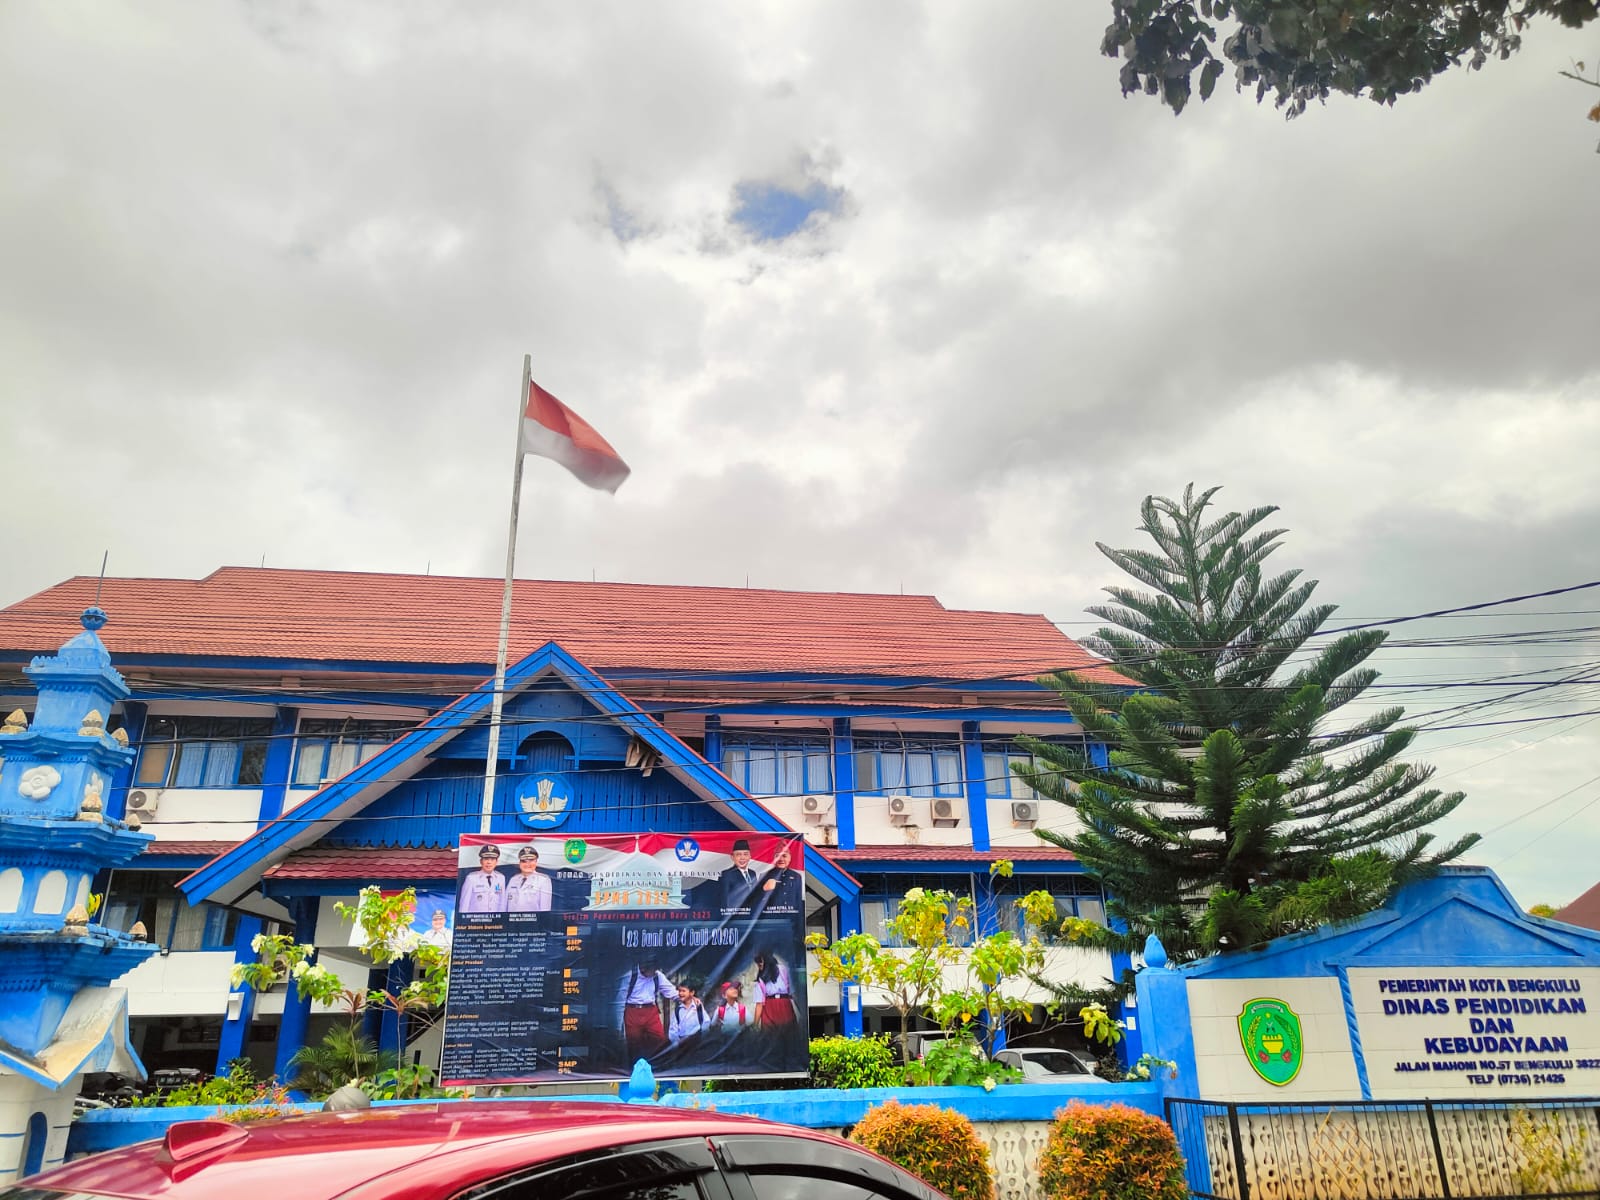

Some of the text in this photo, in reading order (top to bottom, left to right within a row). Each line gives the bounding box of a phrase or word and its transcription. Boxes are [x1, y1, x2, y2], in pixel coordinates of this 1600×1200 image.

[595, 890, 629, 905] SPMB
[594, 911, 640, 921] Penerimaan
[644, 911, 667, 920] Murid
[670, 911, 689, 920] Baru
[1379, 978, 1581, 993] PEMERINTAH KOTA BENGKULU
[1383, 997, 1587, 1015] DINAS PENDIDIKAN
[1469, 1017, 1515, 1034] DAN
[1424, 1036, 1569, 1054] KEBUDAYAAN
[558, 1060, 578, 1068] SMP
[1394, 1061, 1431, 1072] JALAN
[1433, 1061, 1478, 1071] MAHONI
[1514, 1059, 1574, 1070] BENGKULU
[1467, 1074, 1495, 1085] TELP
[1498, 1074, 1531, 1086] (0736)
